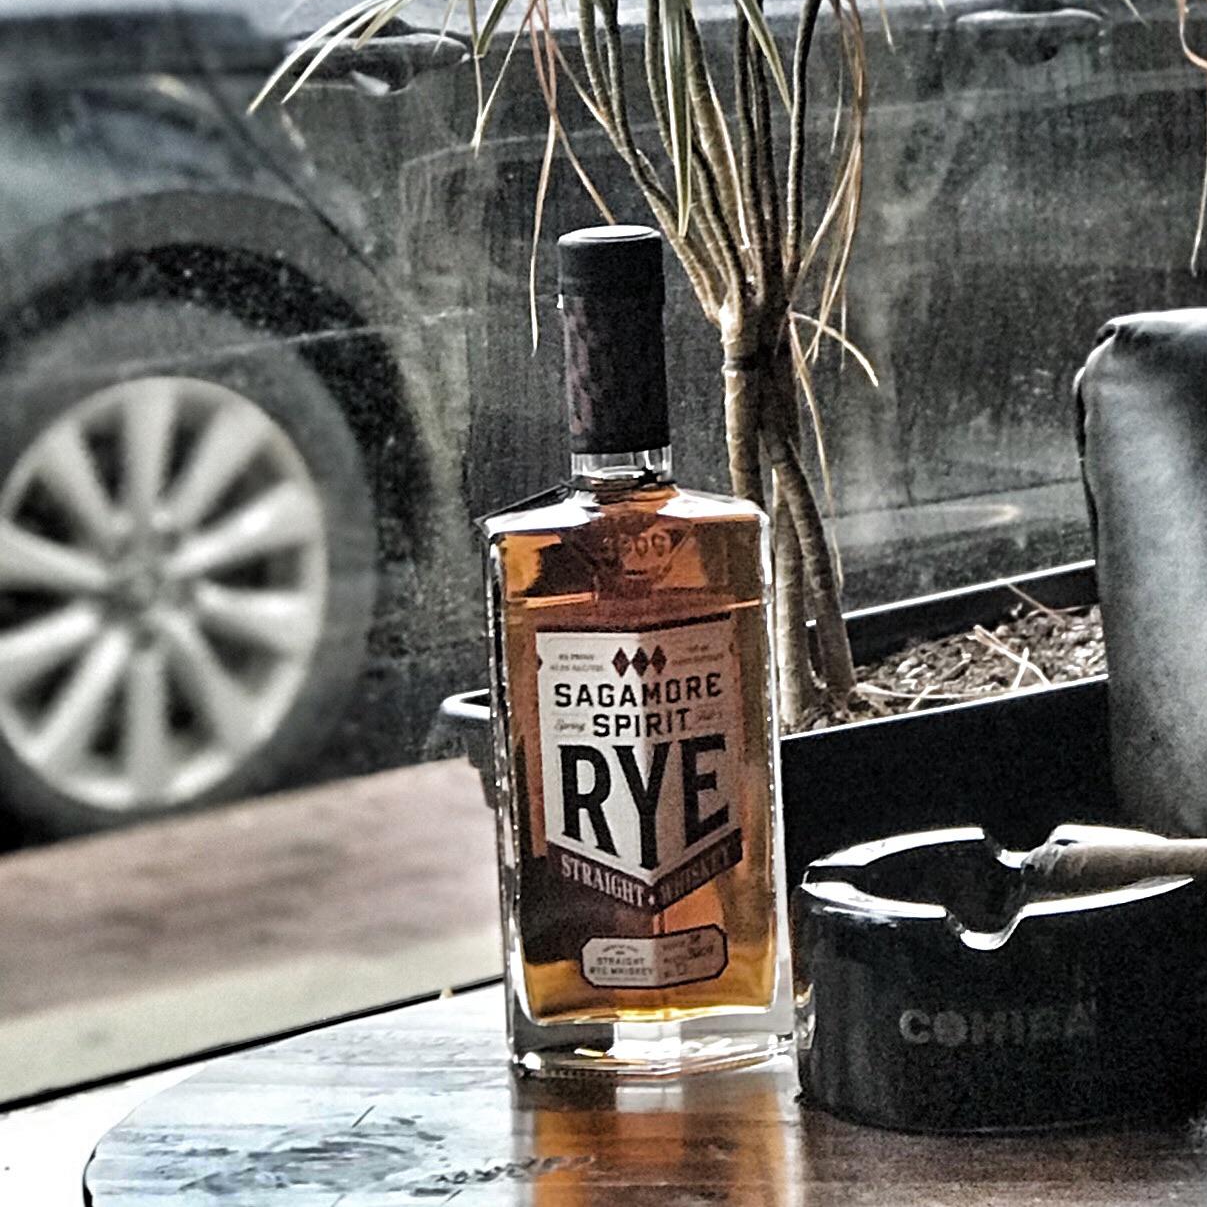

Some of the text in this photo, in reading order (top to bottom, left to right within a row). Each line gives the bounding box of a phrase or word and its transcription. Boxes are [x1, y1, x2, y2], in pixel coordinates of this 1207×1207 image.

[553, 672, 723, 708] SAGAMORE
[592, 707, 691, 738] SPIRIT
[557, 733, 730, 870] RYE
[560, 853, 645, 908] STRAIGHT
